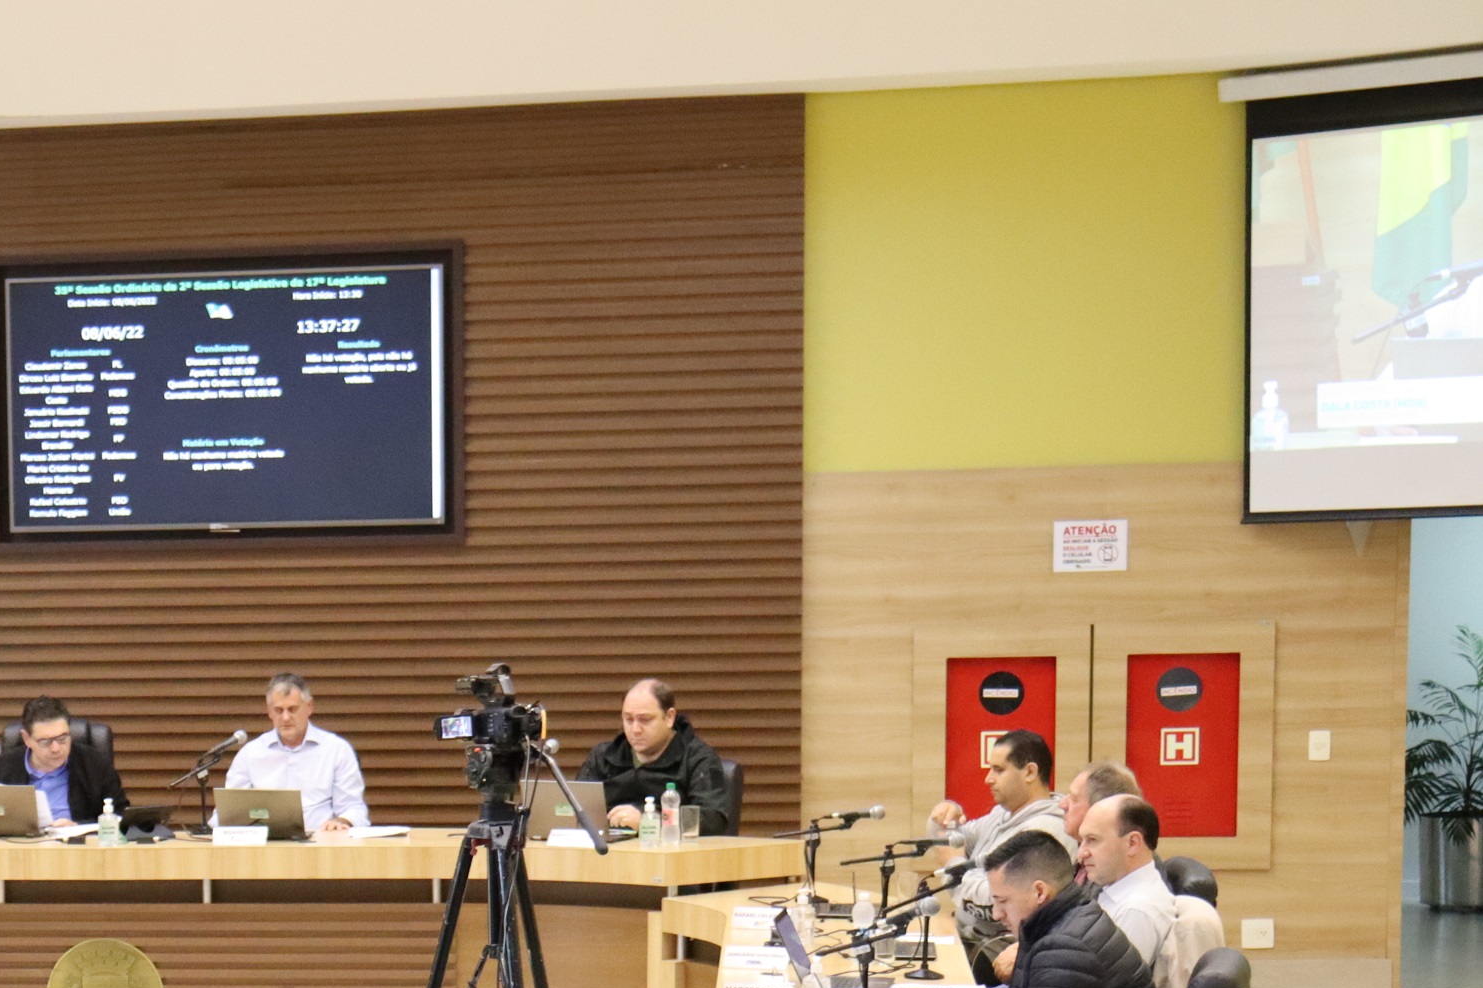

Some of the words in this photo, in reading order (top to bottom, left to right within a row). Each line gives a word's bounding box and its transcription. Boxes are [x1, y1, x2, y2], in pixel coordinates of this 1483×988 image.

[75, 285, 112, 294] Sessão
[113, 283, 162, 293] Ordinária
[163, 282, 177, 291] da
[194, 280, 230, 290] Sessão
[232, 279, 288, 290] Legislativa
[290, 278, 304, 287] da
[327, 276, 386, 287] Legislatura
[339, 290, 363, 299] 13:30
[297, 318, 360, 333] 13:37:27
[81, 325, 144, 341] 08/06/22
[195, 345, 249, 353] Cronômetros
[338, 340, 380, 348] Resultado
[51, 349, 111, 357] Parlamentares
[182, 439, 214, 447] Matéria
[230, 437, 264, 446] Votação
[1063, 523, 1117, 537] ATENÇÃO
[1166, 734, 1193, 759] H
